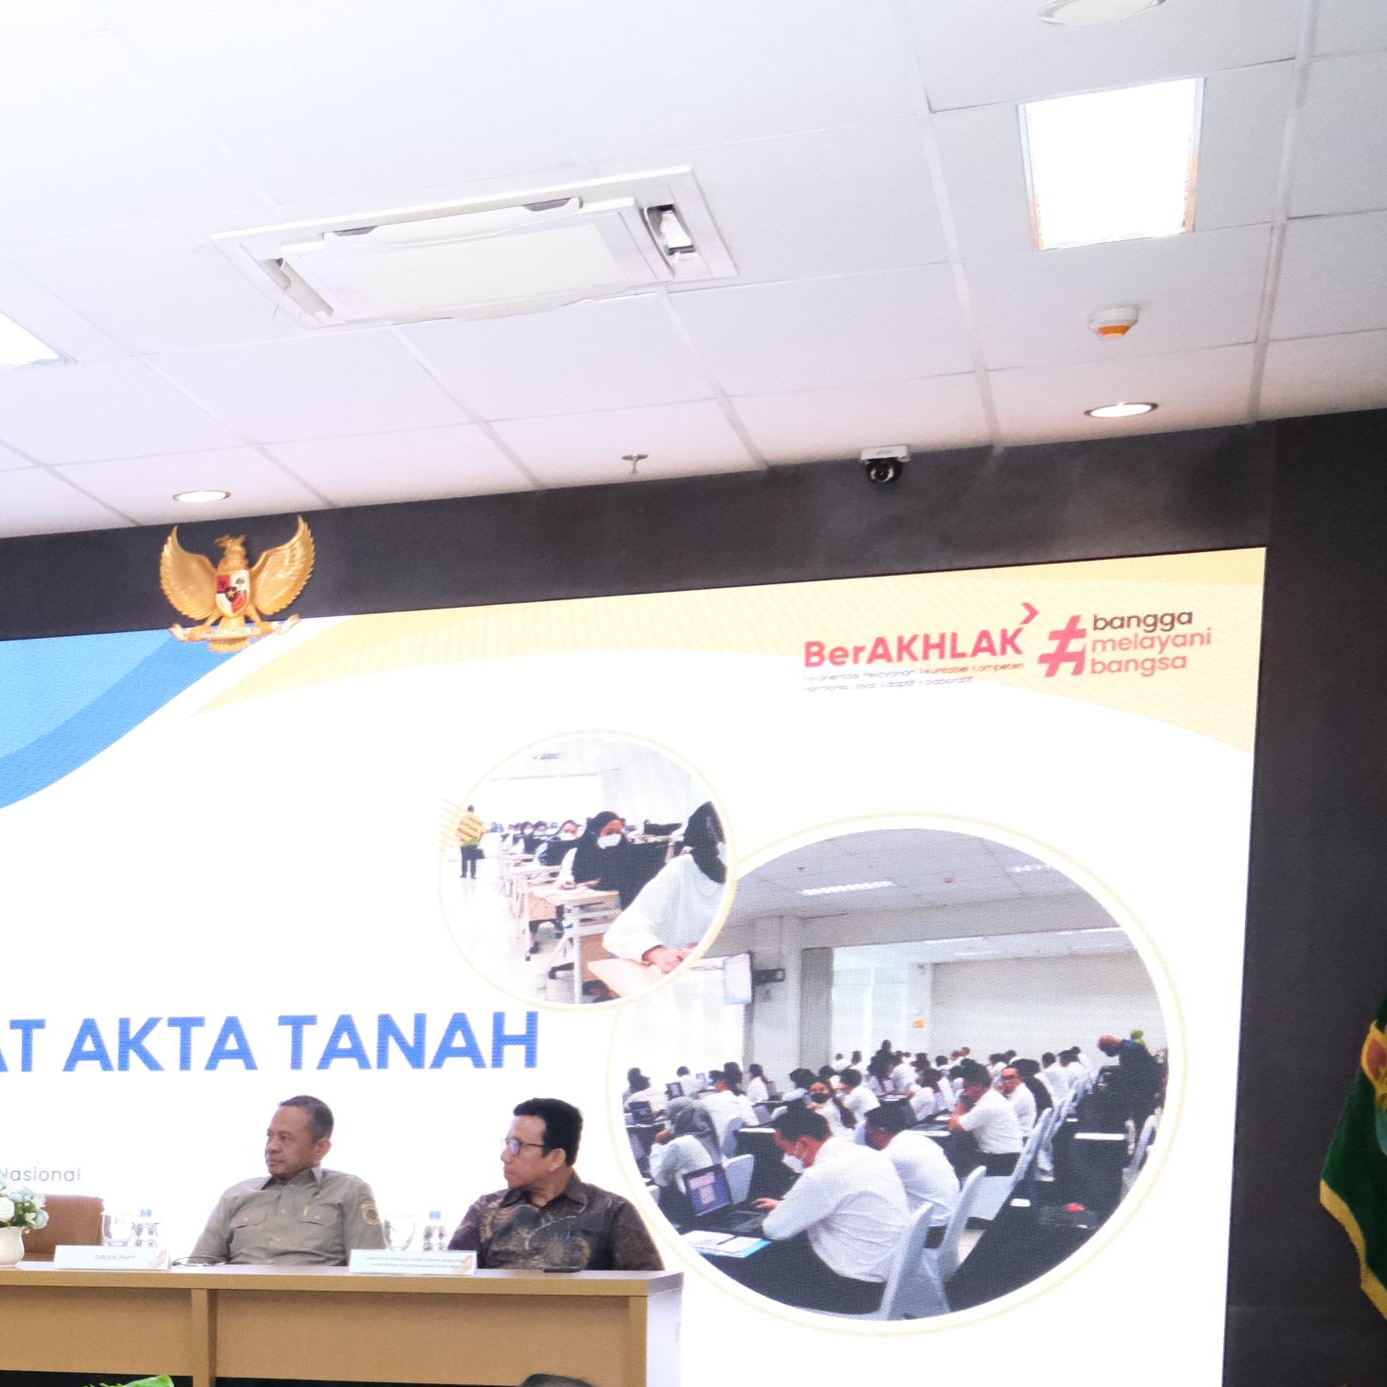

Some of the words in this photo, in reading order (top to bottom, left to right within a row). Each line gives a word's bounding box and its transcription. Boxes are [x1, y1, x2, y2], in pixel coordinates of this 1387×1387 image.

[1093, 611, 1193, 634] bangga
[804, 627, 1024, 668] BerAKHLAK
[1091, 627, 1212, 655] melayani
[1091, 655, 1187, 677] bangsa
[62, 1016, 259, 1072] AKTA
[278, 1011, 539, 1071] TANAH
